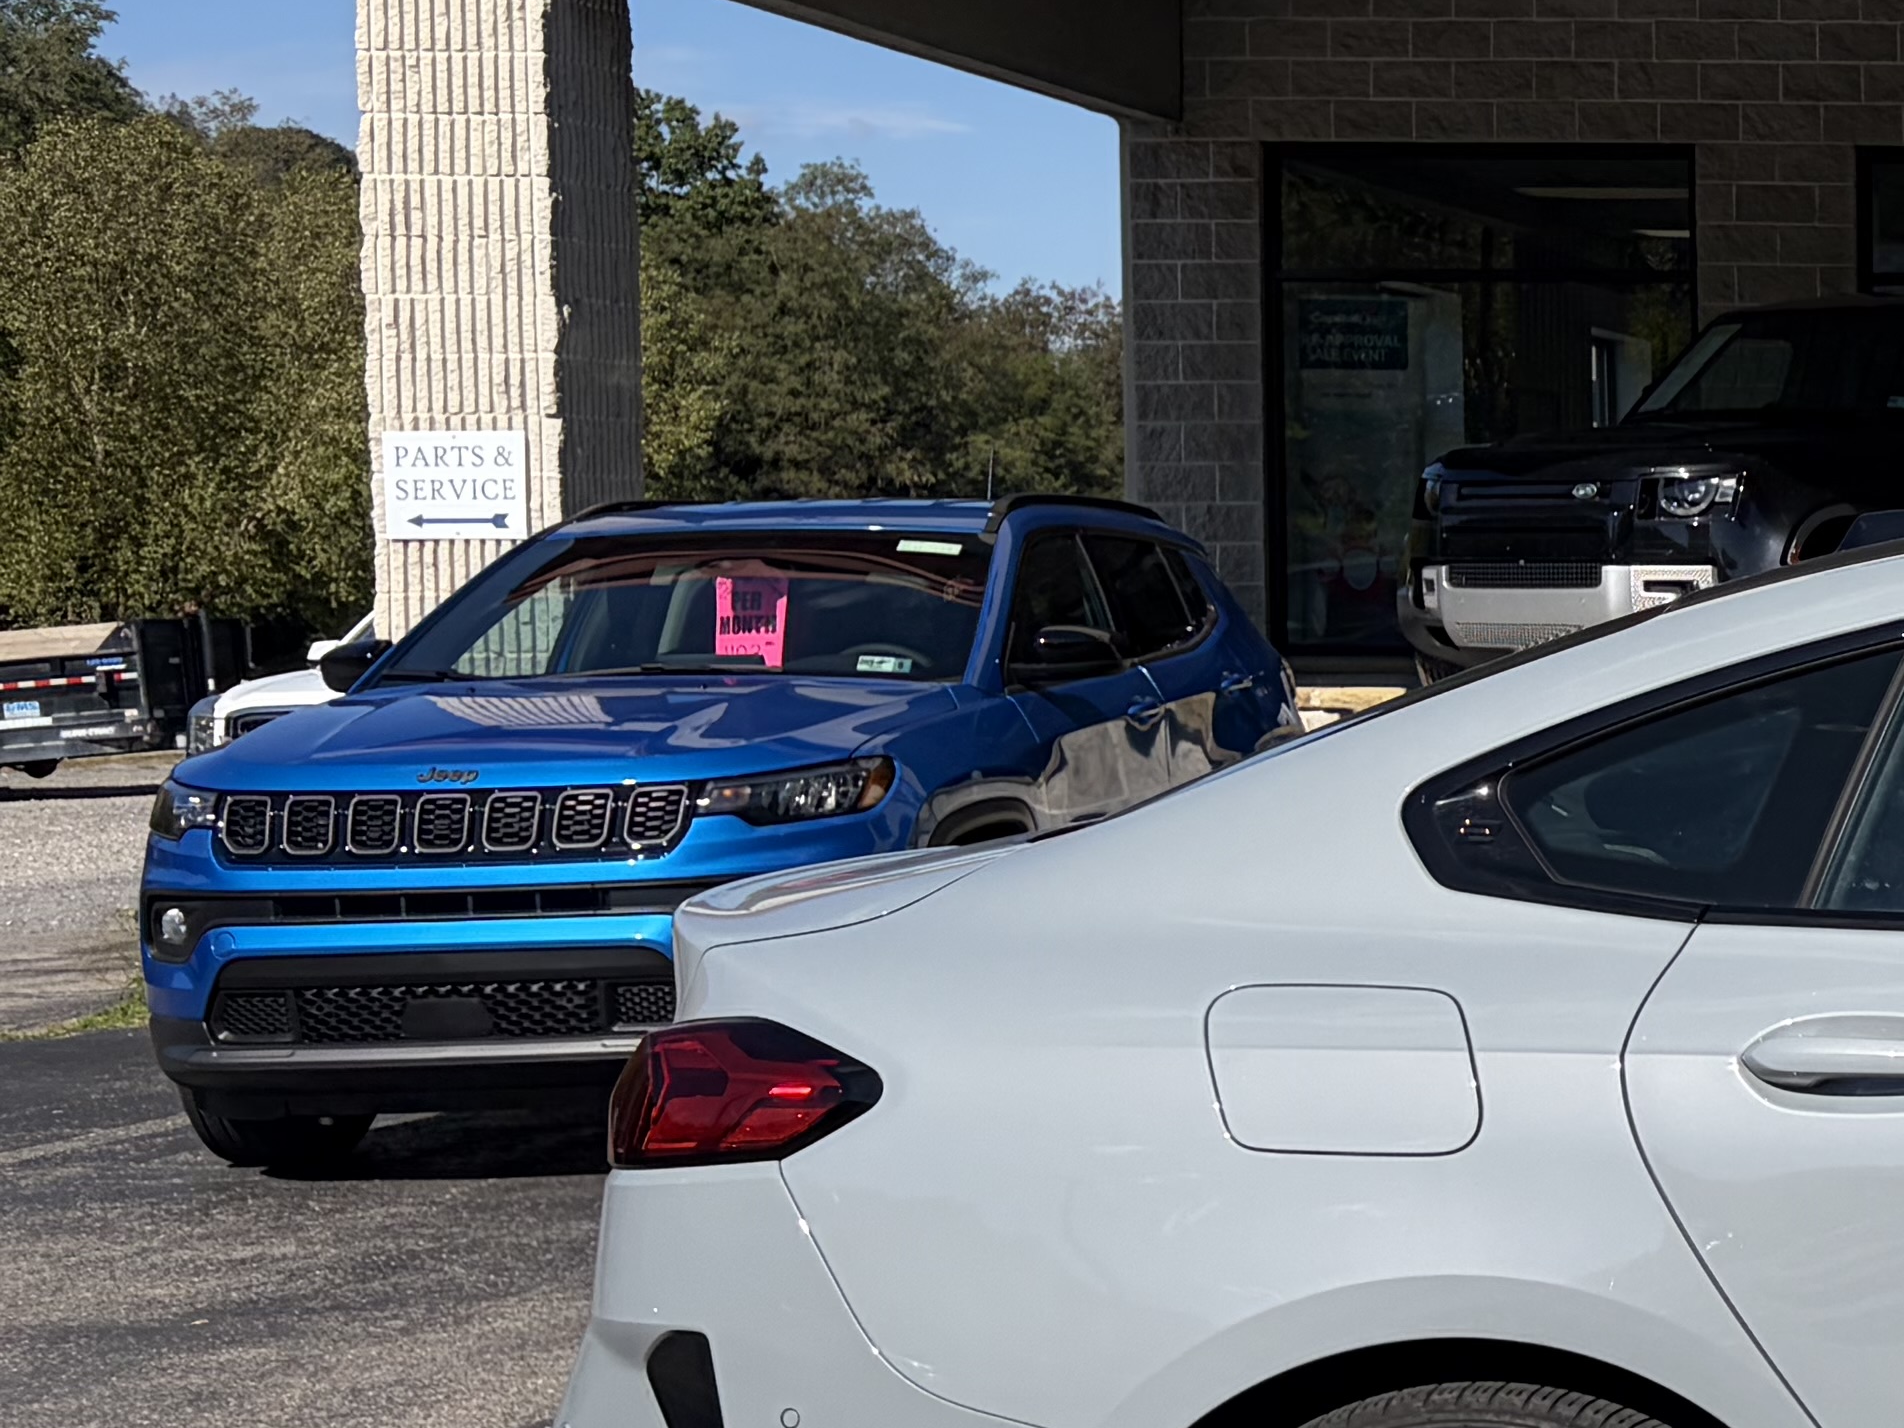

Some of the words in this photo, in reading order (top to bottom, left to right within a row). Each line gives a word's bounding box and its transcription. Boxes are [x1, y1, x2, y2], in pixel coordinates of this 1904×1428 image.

[394, 445, 485, 468] PARTS
[493, 445, 514, 468] &
[395, 478, 516, 501] SERVICE
[734, 590, 762, 612] PER
[719, 615, 778, 636] MONTH
[417, 766, 480, 785] Jeep
